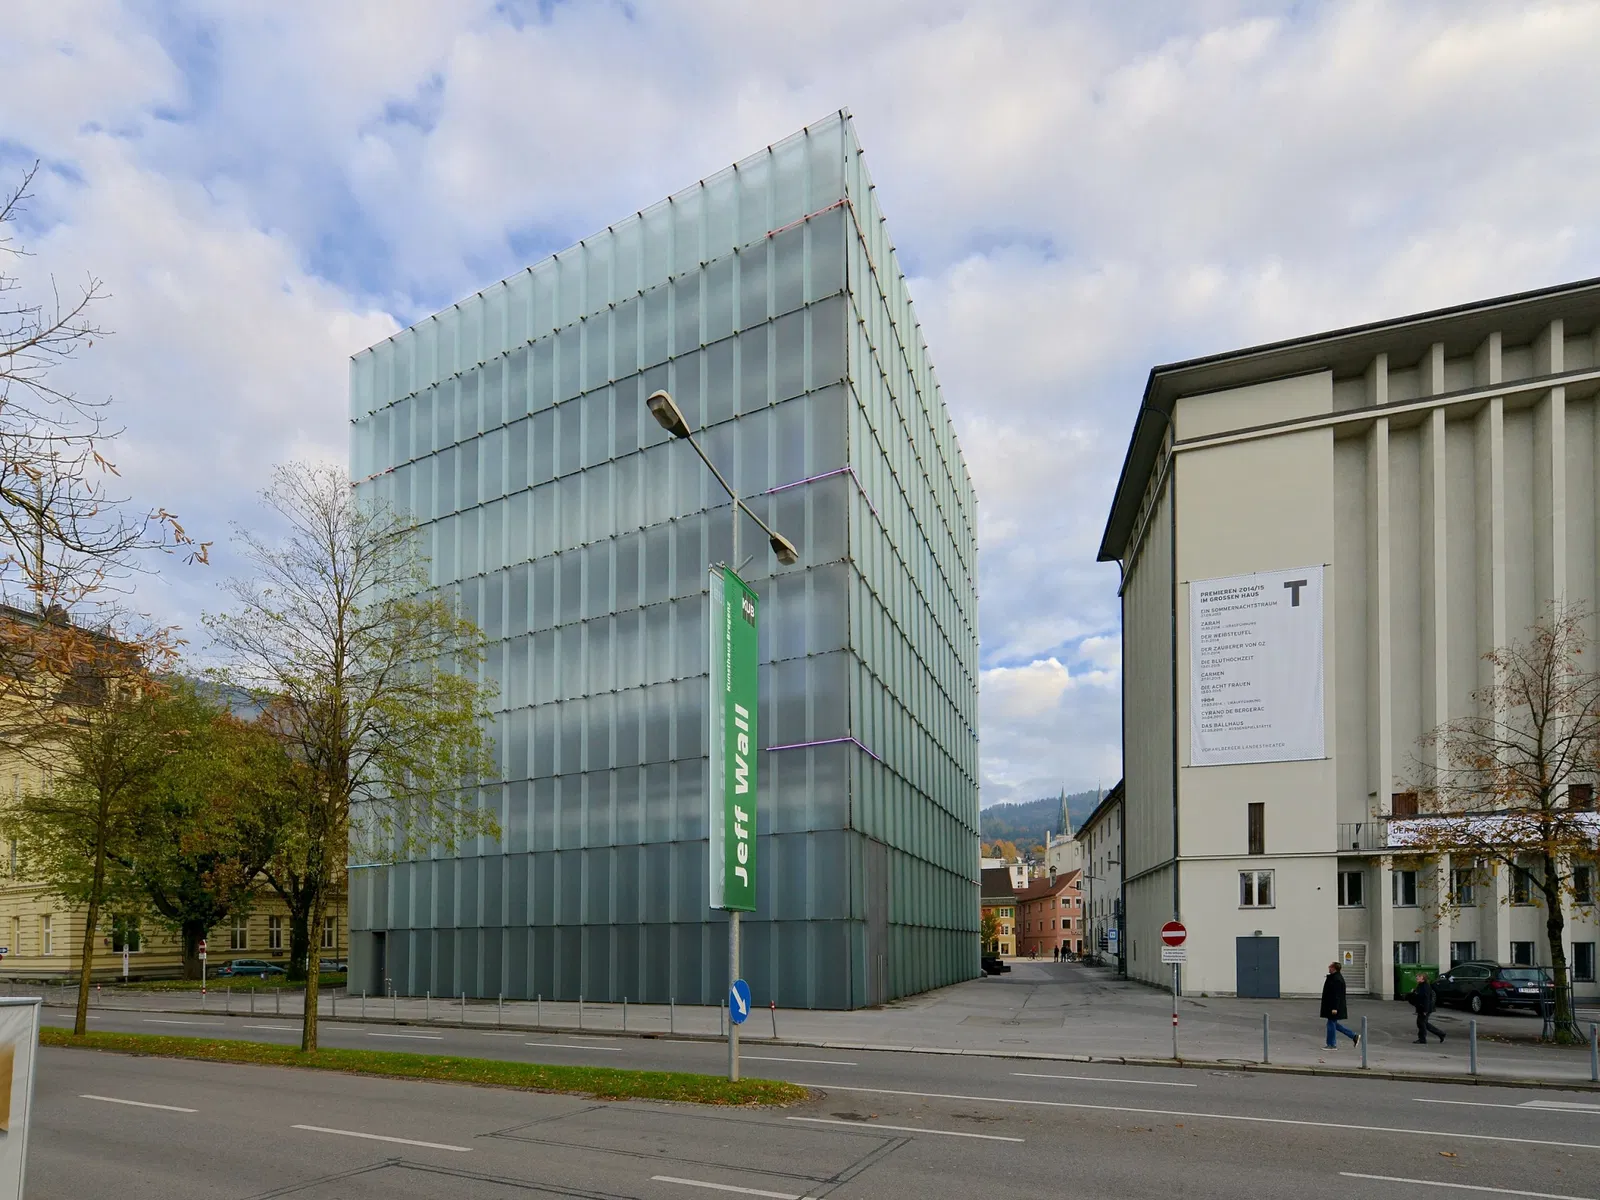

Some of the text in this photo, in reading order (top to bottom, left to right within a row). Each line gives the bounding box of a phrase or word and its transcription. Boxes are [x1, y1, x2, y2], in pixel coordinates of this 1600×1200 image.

[1200, 585, 1264, 597] PREMIEREN 2014/15
[1284, 579, 1307, 607] T
[1210, 594, 1240, 602] GROSSEN
[742, 597, 755, 618] KUB
[1211, 601, 1278, 613] SOMMERNACHTSTRAUM
[1213, 630, 1252, 638] WEIBSTEUFEL
[1213, 643, 1244, 651] ZAUBERER
[1211, 655, 1254, 663] BLUTHOCHZEIT
[734, 703, 749, 888] Jeff Wall
